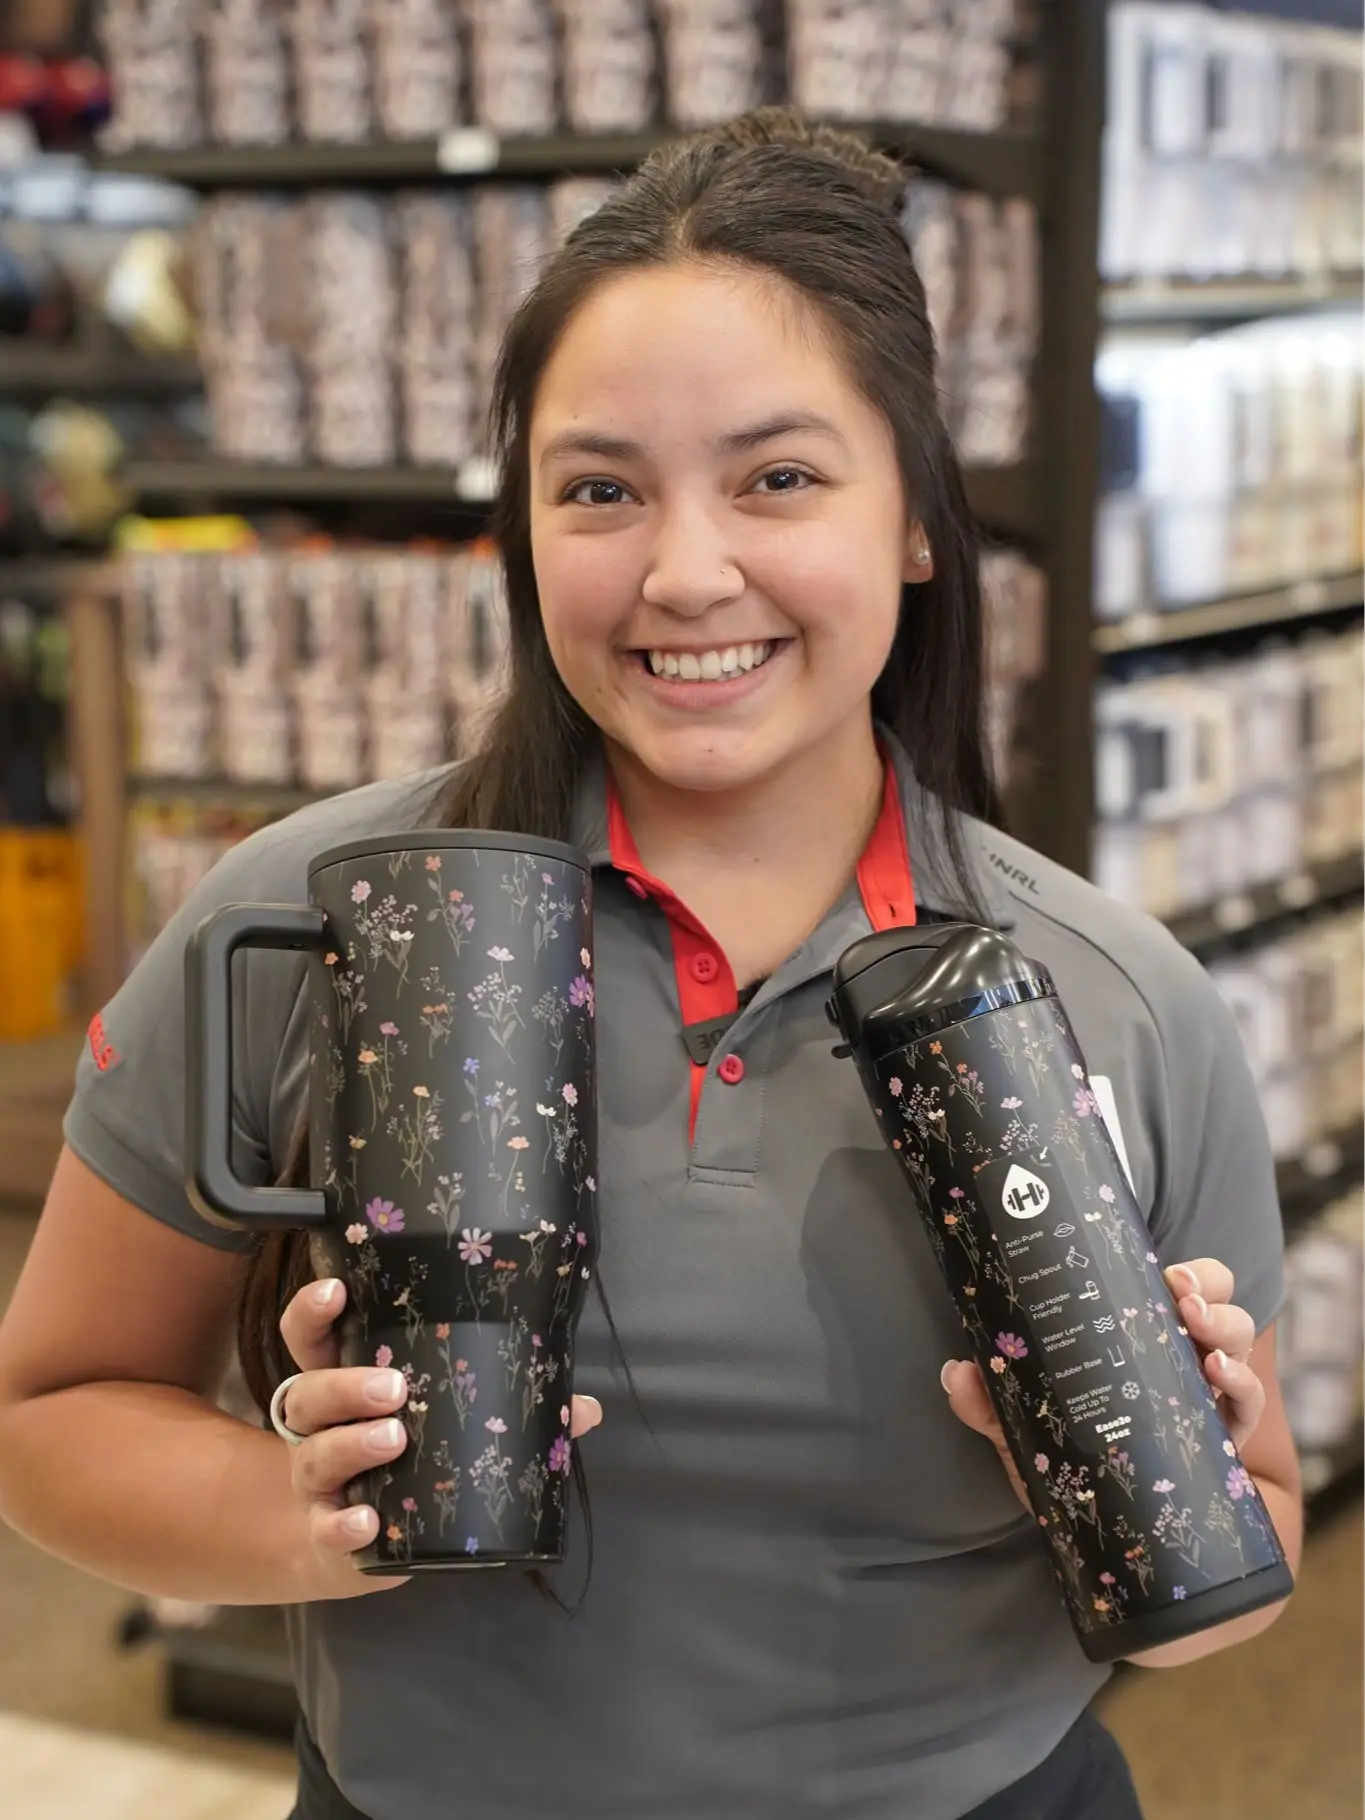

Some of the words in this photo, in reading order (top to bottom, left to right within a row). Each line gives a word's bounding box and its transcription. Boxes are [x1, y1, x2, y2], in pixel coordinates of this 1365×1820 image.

[1005, 1230, 1044, 1249] Anti-Purse
[1008, 1245, 1030, 1258] Straw
[1018, 1272, 1040, 1284] Chug
[1039, 1263, 1062, 1276] Spout
[1029, 1302, 1045, 1312] Cup
[1045, 1292, 1071, 1306] Holder
[1032, 1305, 1063, 1321] Friendly
[1041, 1331, 1064, 1344] Water
[1064, 1322, 1085, 1336] Level
[1044, 1337, 1077, 1353] Window
[1054, 1364, 1083, 1380] Rubber
[1083, 1358, 1103, 1369] Base
[1066, 1392, 1090, 1406] Keeps
[1088, 1384, 1112, 1397] Water
[1069, 1403, 1087, 1414] Cold
[1087, 1399, 1100, 1408] Up
[1099, 1395, 1110, 1403] To
[1072, 1414, 1083, 1424] 24
[1083, 1406, 1107, 1420] Hours
[1104, 1427, 1132, 1443] 24oz
